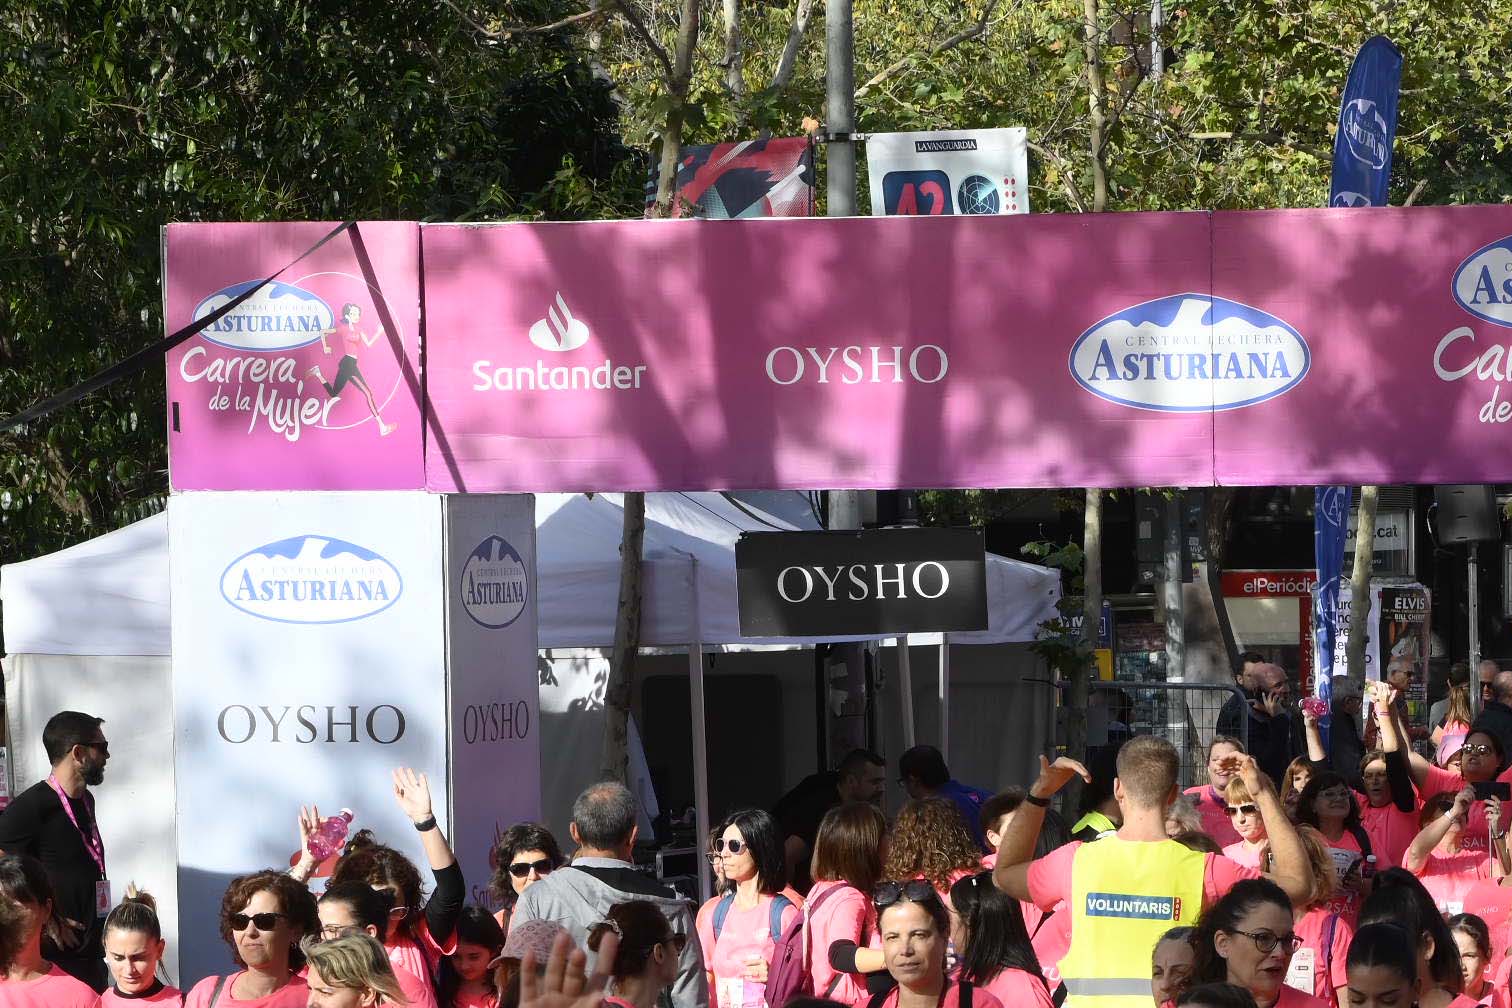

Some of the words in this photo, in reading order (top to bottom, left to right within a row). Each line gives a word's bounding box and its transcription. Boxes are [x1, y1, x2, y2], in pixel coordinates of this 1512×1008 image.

[204, 307, 323, 332] ASTURIANA
[1125, 335, 1200, 347] CENTRAL
[1207, 334, 1284, 346] LECHERA
[180, 346, 297, 383] Carrera
[473, 358, 647, 392] Santander
[765, 344, 949, 387] OYSHO
[1088, 338, 1292, 382] ASTURIANA
[208, 384, 229, 411] de
[235, 385, 251, 411] la
[248, 381, 342, 442] Mujer
[1479, 385, 1512, 423] de
[234, 567, 390, 602] ASTURIANA
[466, 570, 525, 606] ASTURIANA
[777, 561, 950, 605] OYSHO
[217, 704, 406, 744] OYSHO
[463, 700, 530, 744] OYSHO
[1087, 898, 1171, 916] VOLUNTARIS
